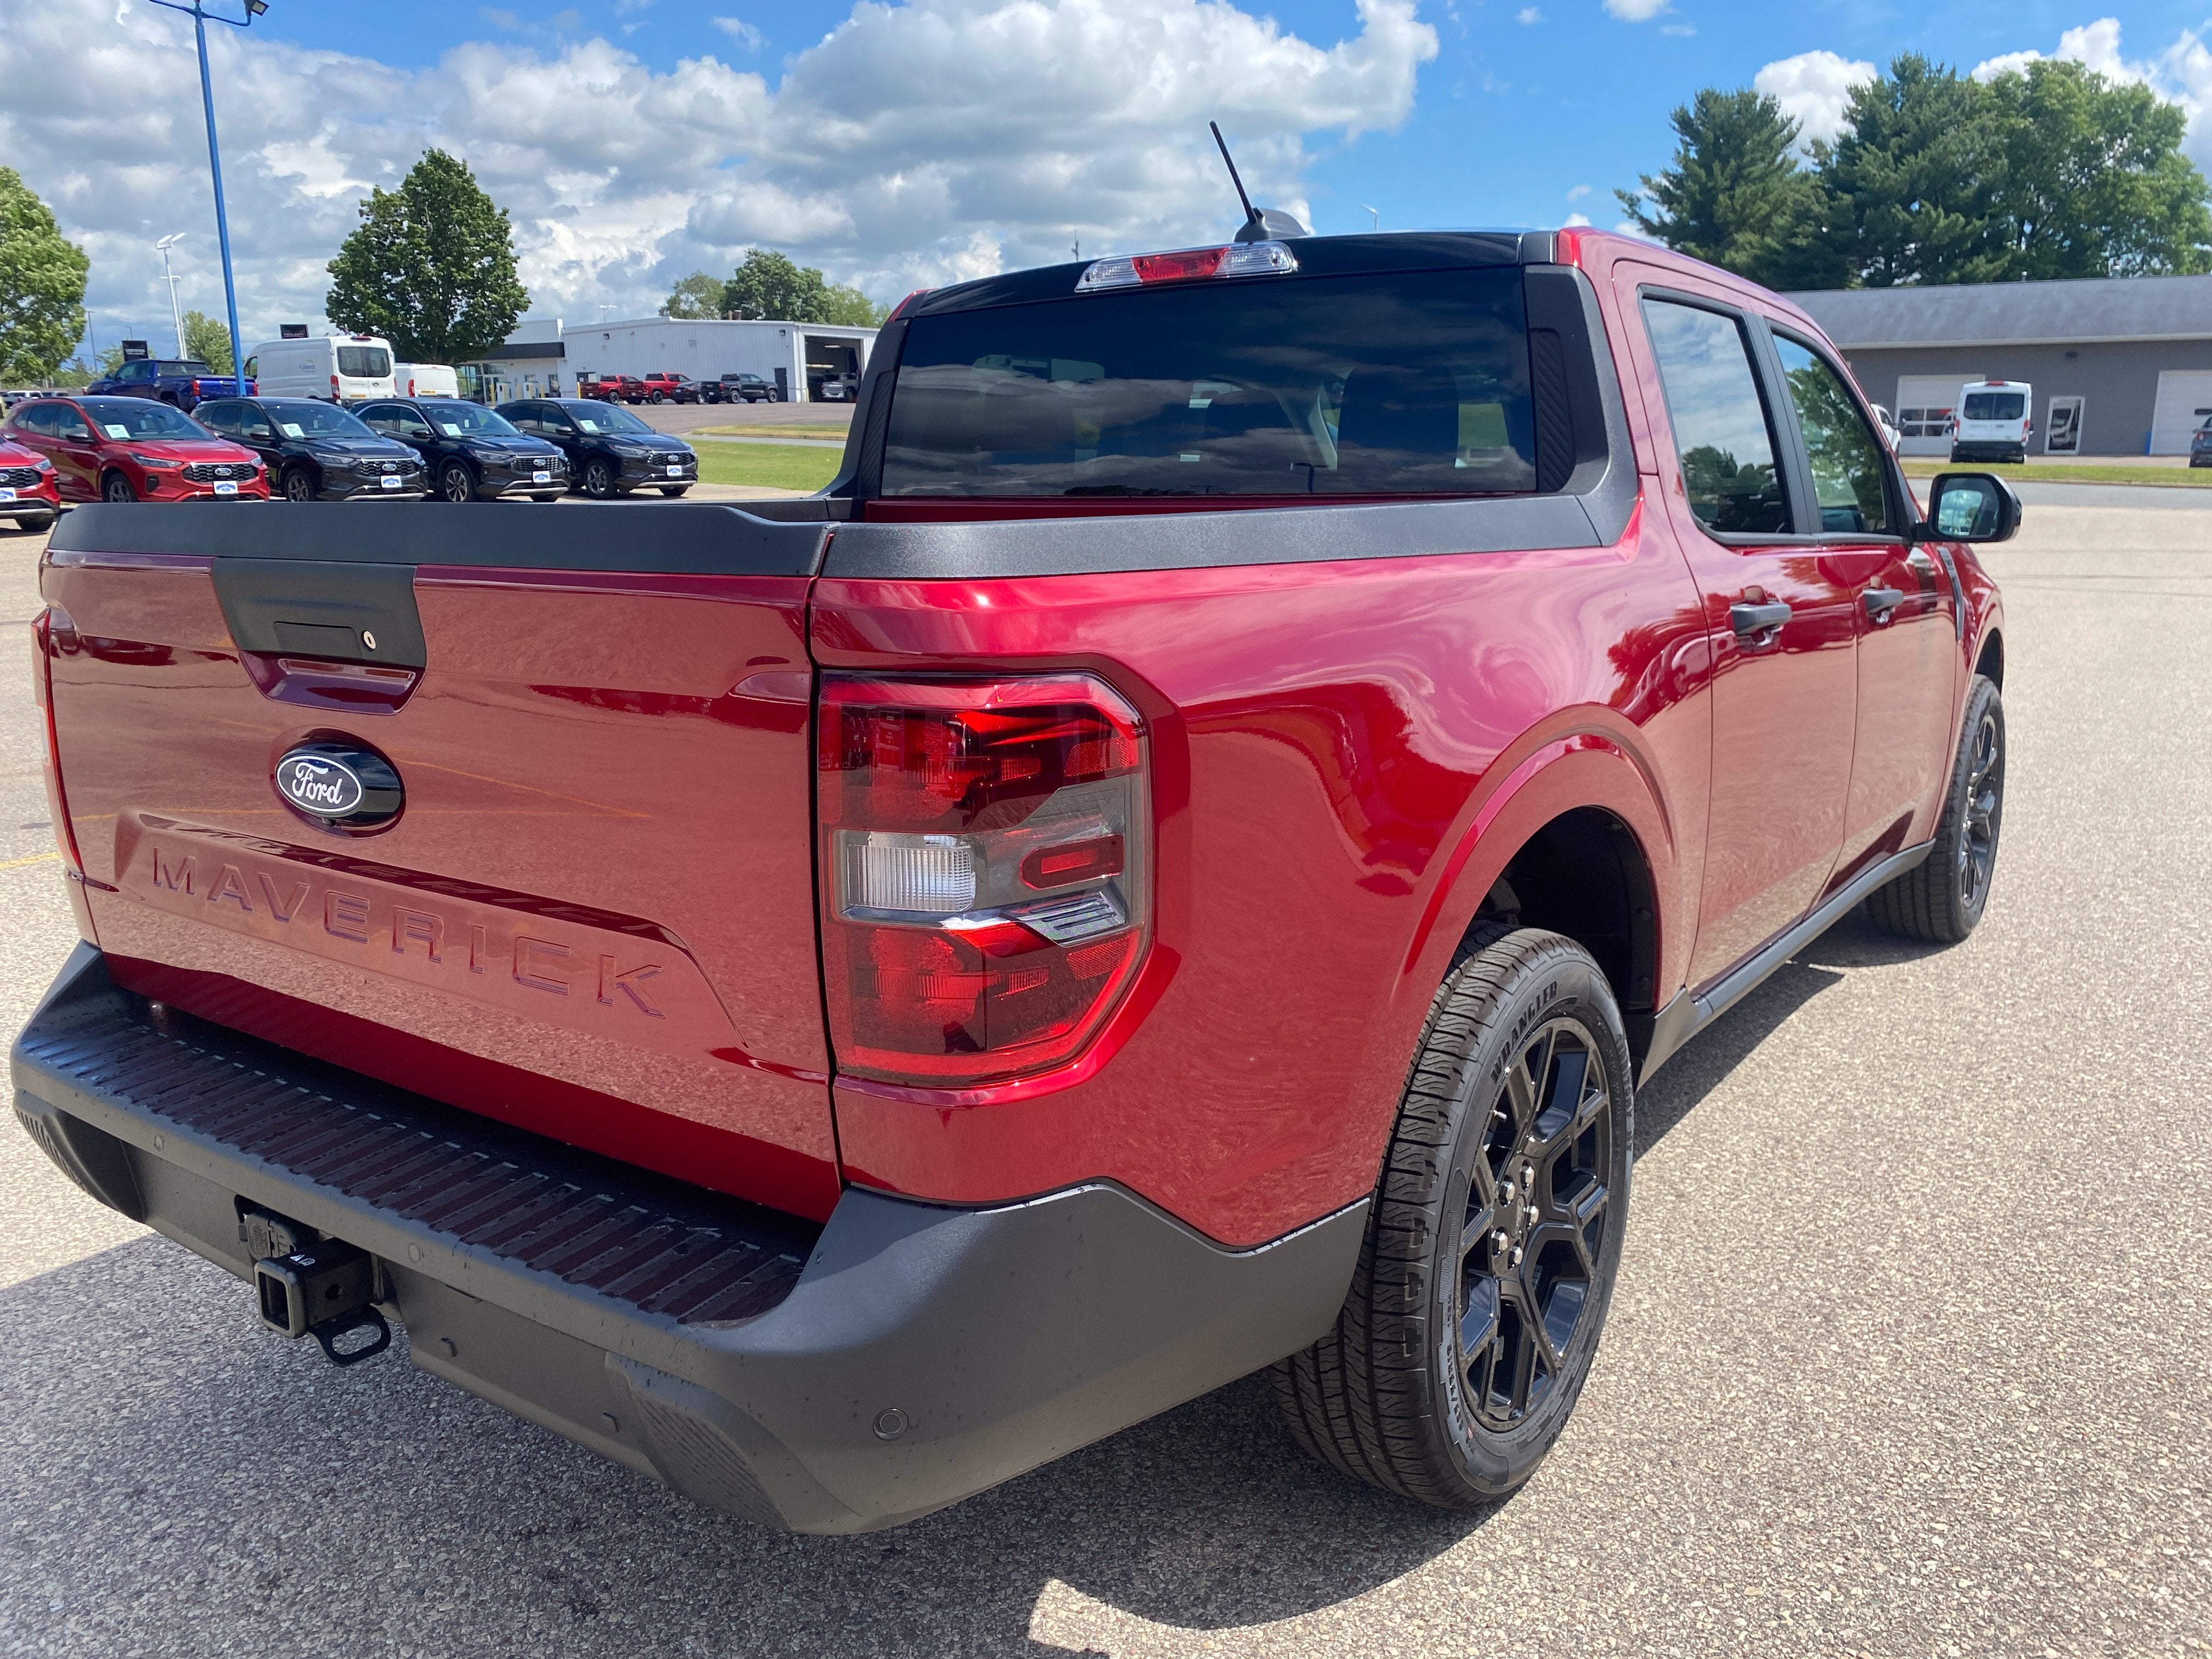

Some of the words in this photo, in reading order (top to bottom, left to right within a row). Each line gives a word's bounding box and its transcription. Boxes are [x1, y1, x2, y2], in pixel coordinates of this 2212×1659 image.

[292, 762, 343, 804] Ford
[154, 847, 665, 1019] MAVERICK
[1490, 981, 1558, 1085] WRANGLER
